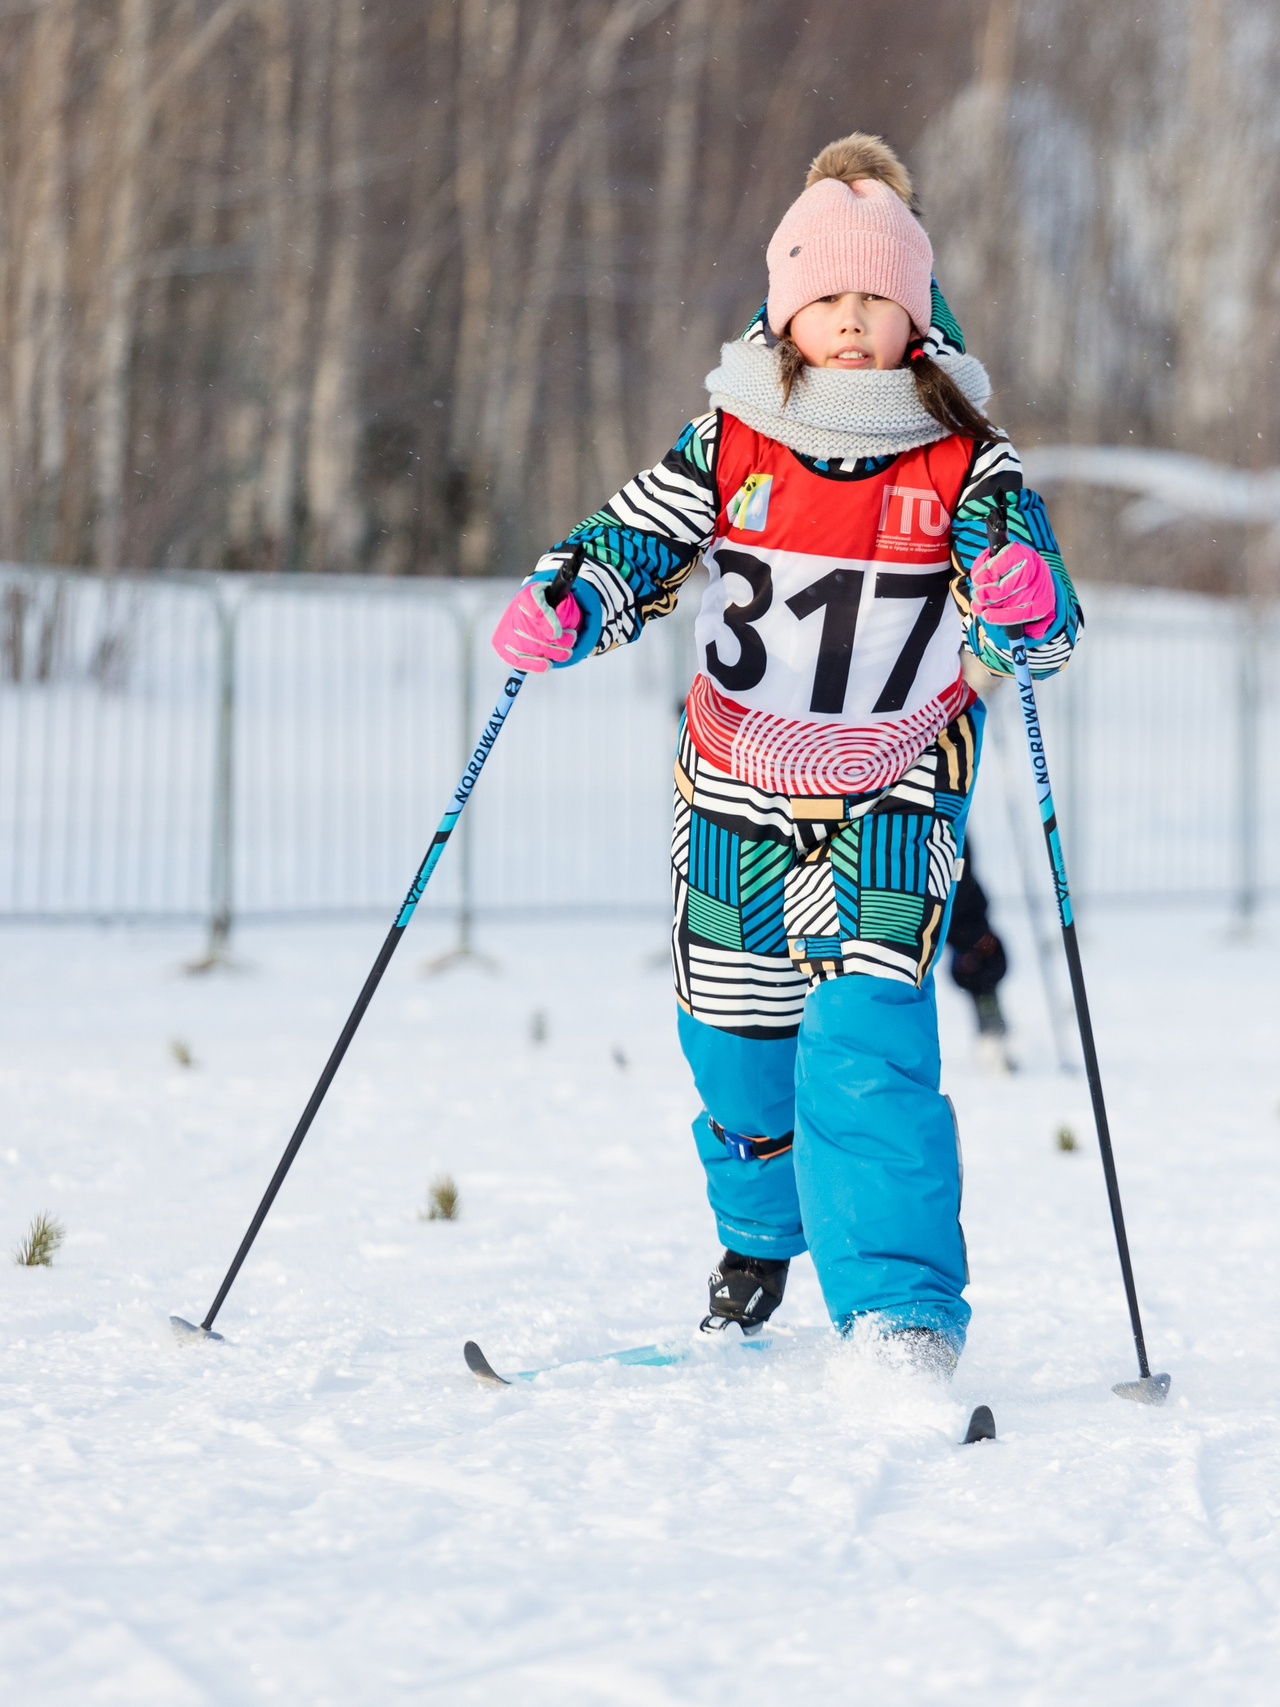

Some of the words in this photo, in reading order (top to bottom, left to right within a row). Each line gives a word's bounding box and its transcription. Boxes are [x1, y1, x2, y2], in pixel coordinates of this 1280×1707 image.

[705, 549, 950, 714] 317
[454, 706, 507, 804] NORDWAY
[1019, 681, 1049, 785] NORDWAY
